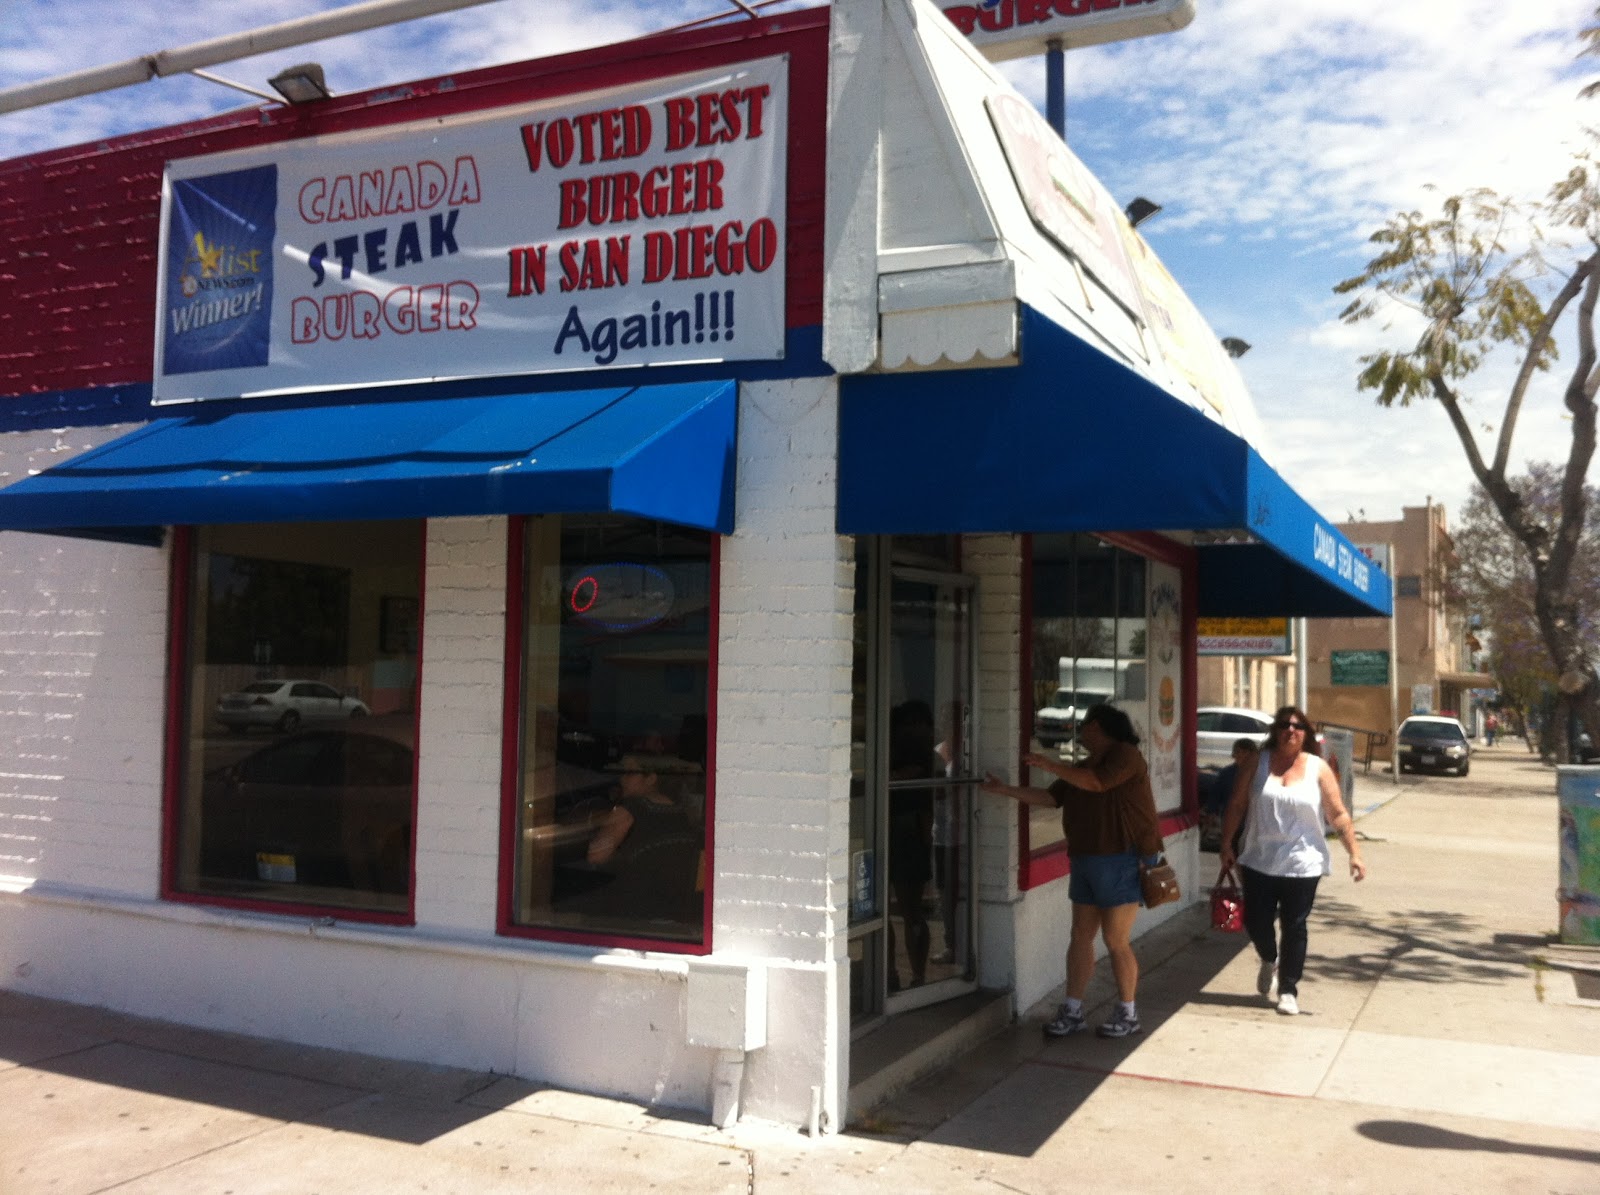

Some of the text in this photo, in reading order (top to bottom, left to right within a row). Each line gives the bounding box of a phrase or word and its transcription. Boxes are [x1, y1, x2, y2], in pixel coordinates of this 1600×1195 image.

[943, 0, 1157, 36] BURG
[520, 84, 770, 172] VOTED BEST
[298, 155, 481, 224] CANADA
[557, 158, 725, 230] BURGER
[308, 209, 460, 288] STEAK
[507, 217, 778, 297] IN SAN DIEGO
[291, 280, 480, 344] BURGER
[554, 289, 735, 365] Again!!!
